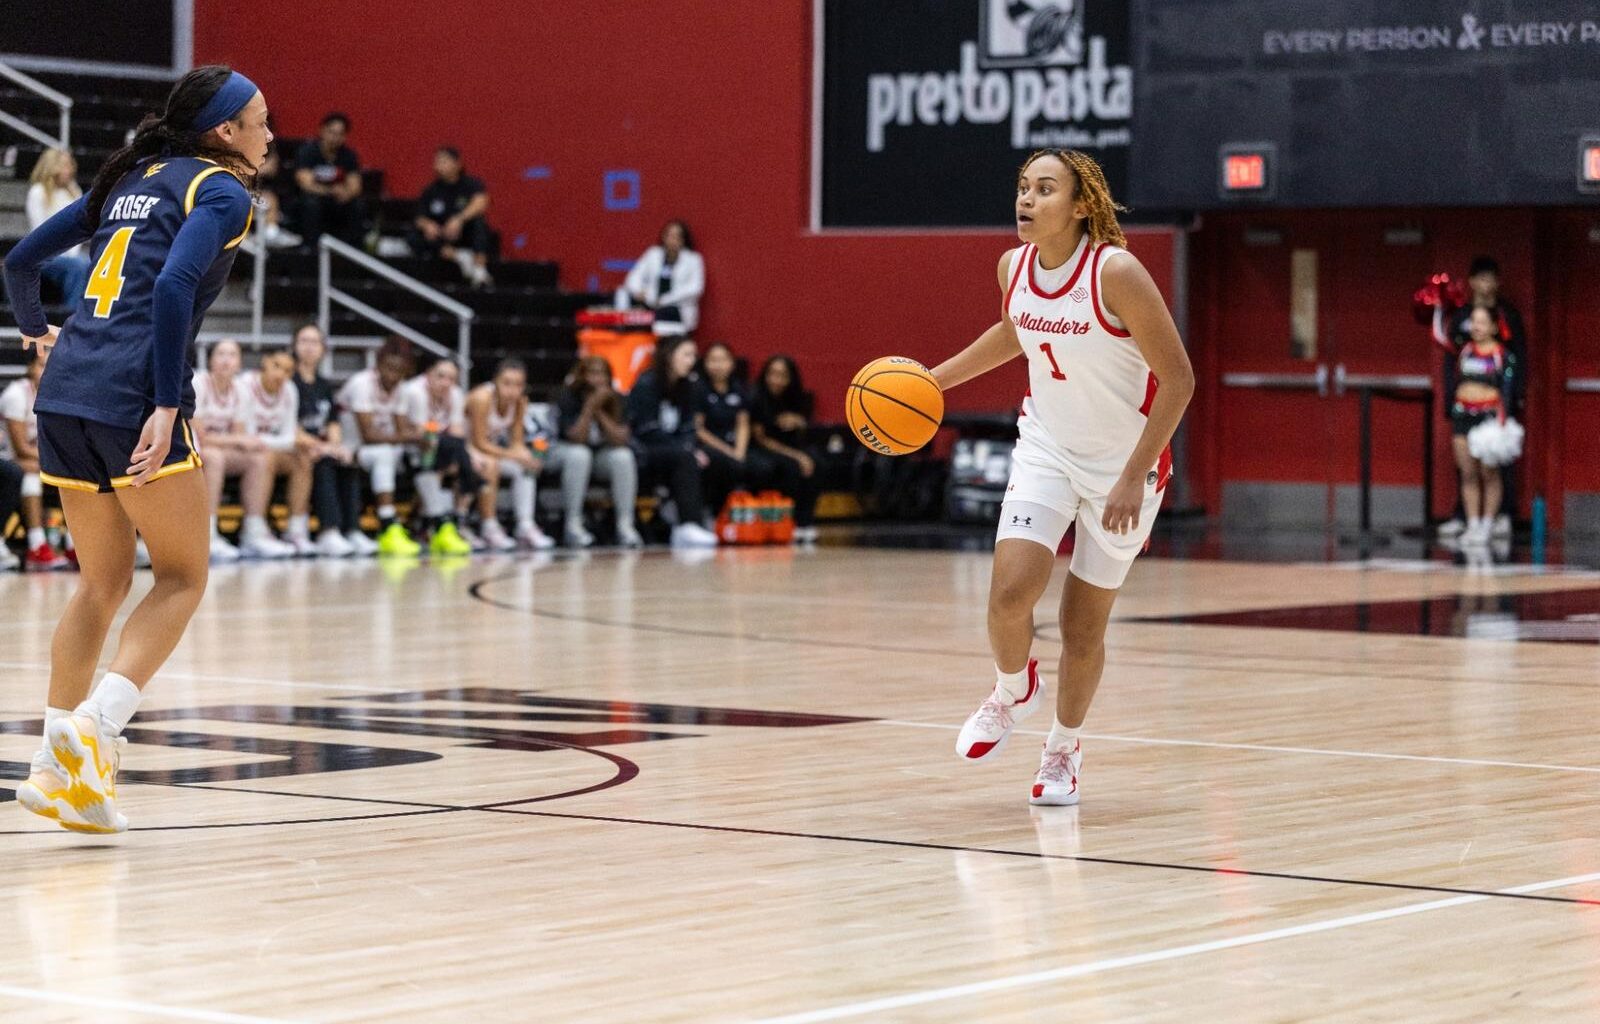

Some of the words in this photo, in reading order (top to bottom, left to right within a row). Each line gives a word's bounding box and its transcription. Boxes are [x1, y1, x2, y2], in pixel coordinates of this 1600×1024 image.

[1263, 28, 1344, 53] EVERY
[1346, 26, 1450, 50] PERSON
[1491, 22, 1575, 47] EVERY
[108, 194, 161, 220] ROSE
[84, 226, 137, 319] 4
[1013, 312, 1091, 335] Matadors
[1039, 342, 1067, 381] 1
